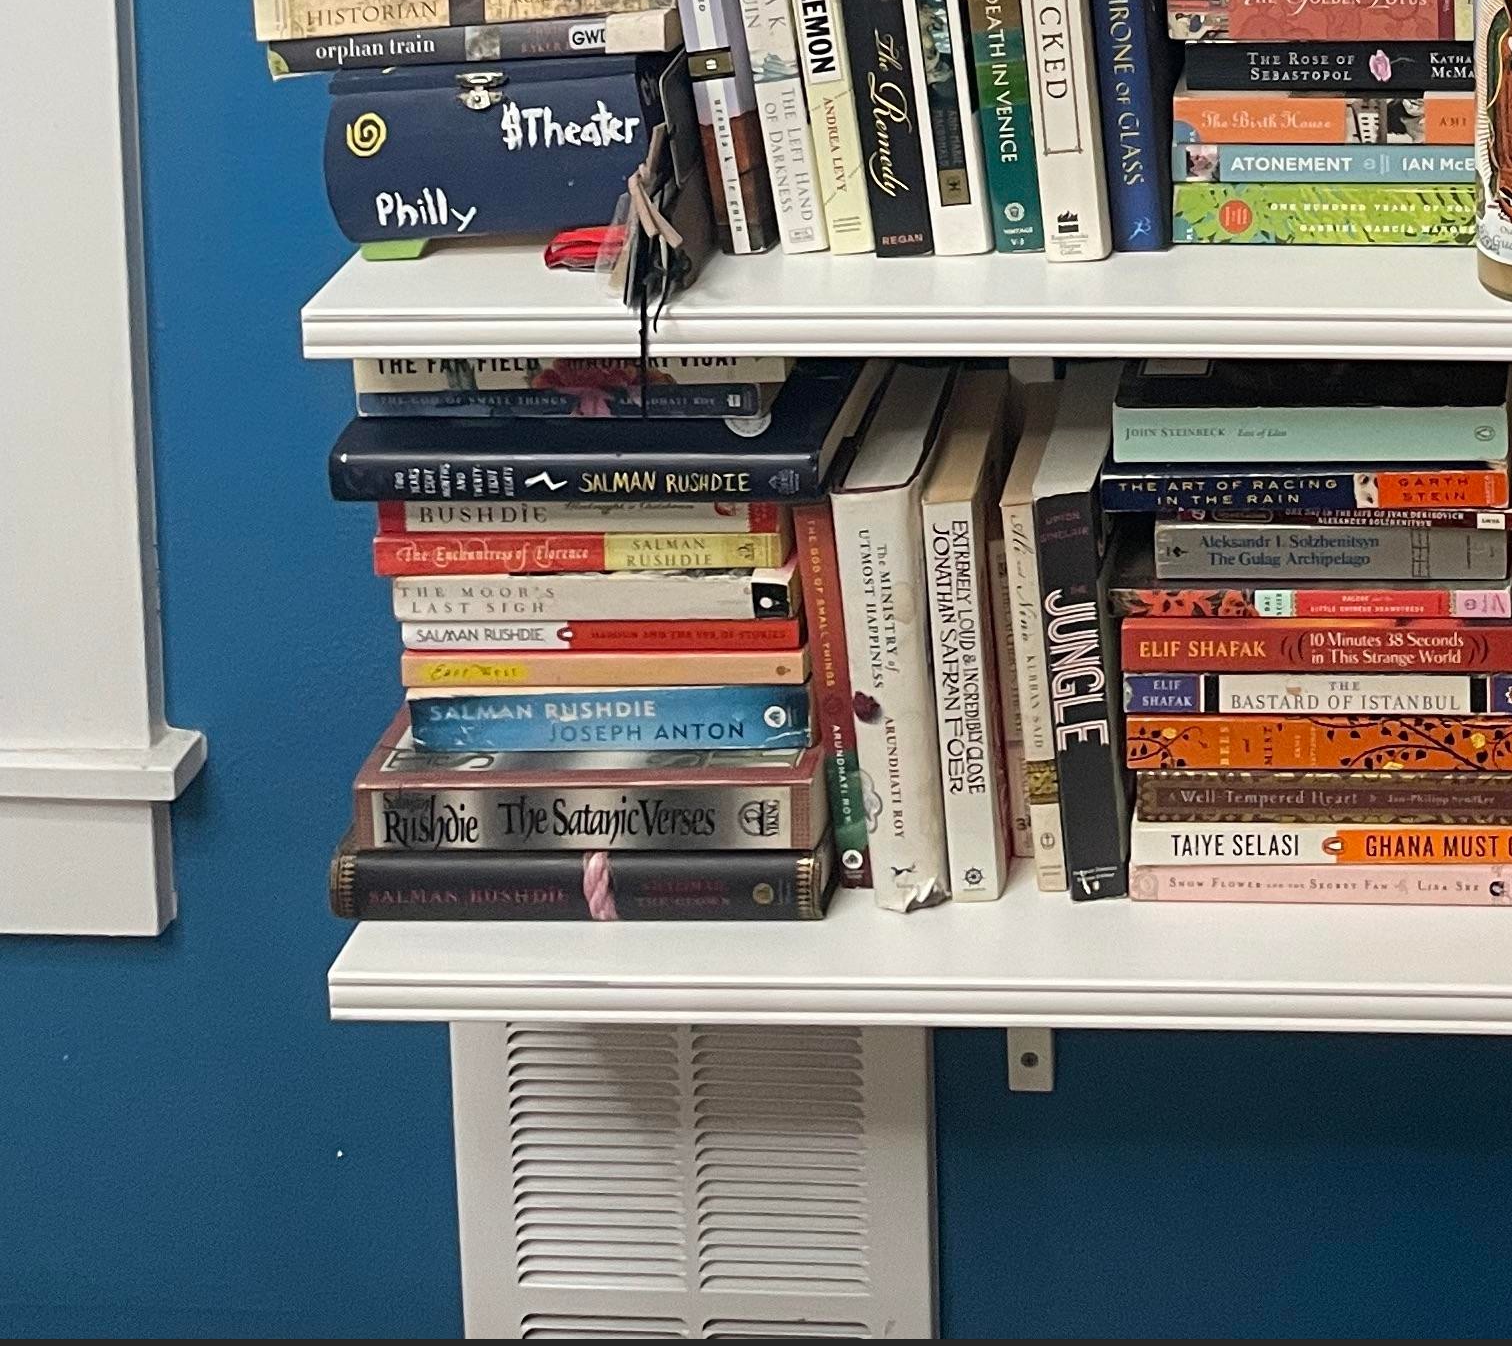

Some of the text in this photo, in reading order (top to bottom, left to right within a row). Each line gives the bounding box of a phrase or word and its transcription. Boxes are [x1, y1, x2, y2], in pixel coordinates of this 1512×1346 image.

[1230, 157, 1353, 172] ATONEMENT
[375, 189, 477, 232] Philly
[578, 471, 752, 495] SALMAN RUSHDIE
[1139, 640, 1267, 658] ELIF SHAFAK
[1310, 632, 1465, 648] 10 Minutes 38 Seconds
[1044, 587, 1109, 752] JUNGLE
[1311, 647, 1463, 669] in This Strange World
[498, 794, 716, 846] The Satanic Verses
[1171, 834, 1300, 857] TAIYE SELASI
[1365, 836, 1435, 858] GHANA
[1443, 835, 1500, 858] MUST
